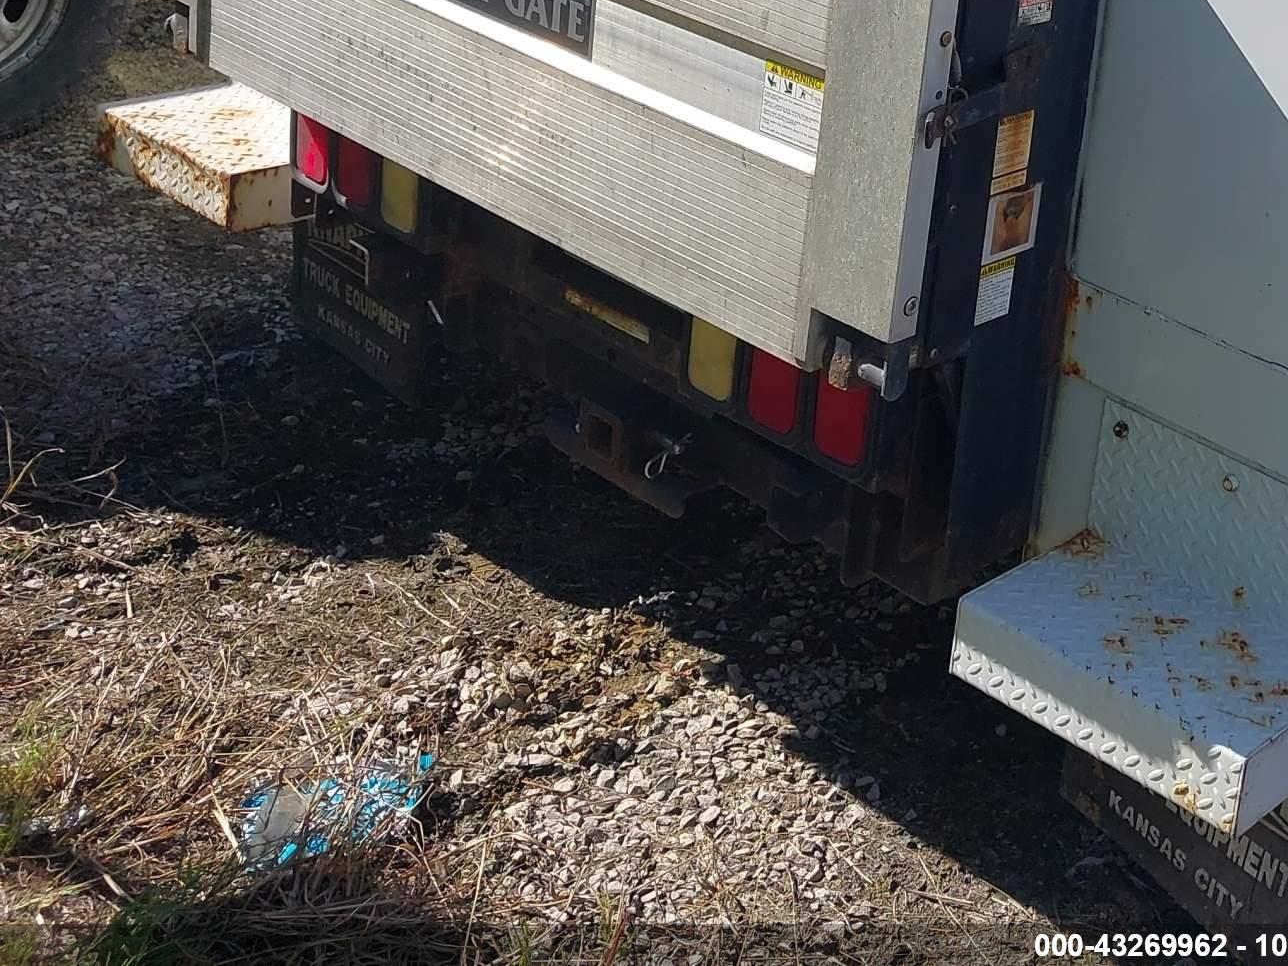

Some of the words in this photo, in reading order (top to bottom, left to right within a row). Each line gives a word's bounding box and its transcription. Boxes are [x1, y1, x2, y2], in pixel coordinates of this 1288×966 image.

[780, 64, 823, 90] WARNING
[988, 256, 1015, 273] WARNING
[303, 256, 341, 299] TRUCK
[345, 284, 410, 345] EQUIPMENT
[317, 304, 361, 346] KANSAS
[365, 337, 390, 366] CITY
[1108, 789, 1188, 873] KANSAS
[1194, 867, 1244, 921] CITY
